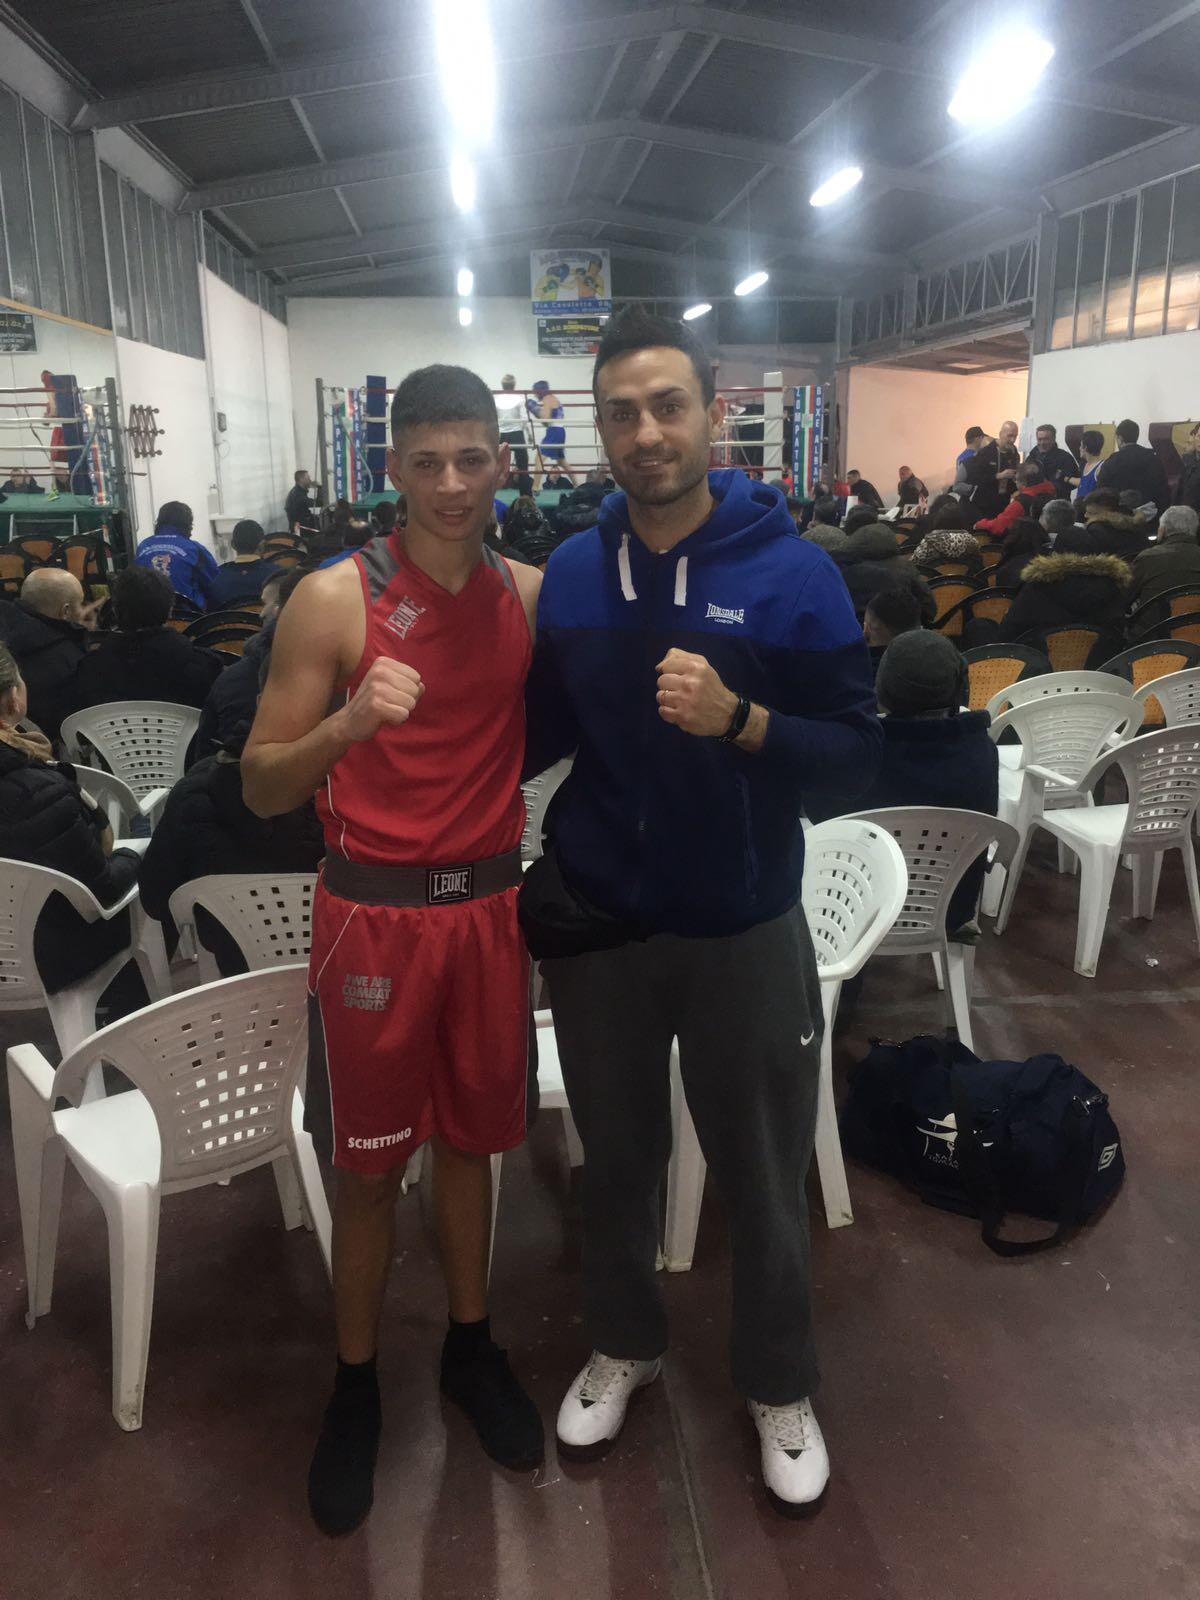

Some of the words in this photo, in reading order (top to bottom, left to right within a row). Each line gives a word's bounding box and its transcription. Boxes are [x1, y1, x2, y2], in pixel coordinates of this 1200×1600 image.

[383, 595, 427, 640] LEONE
[705, 602, 745, 624] LONSDALE
[433, 871, 468, 897] LEONE
[342, 985, 391, 1000] COMBAT
[370, 976, 392, 988] ARE
[344, 997, 386, 1011] SPORTS
[347, 1127, 412, 1149] SCHETTINO
